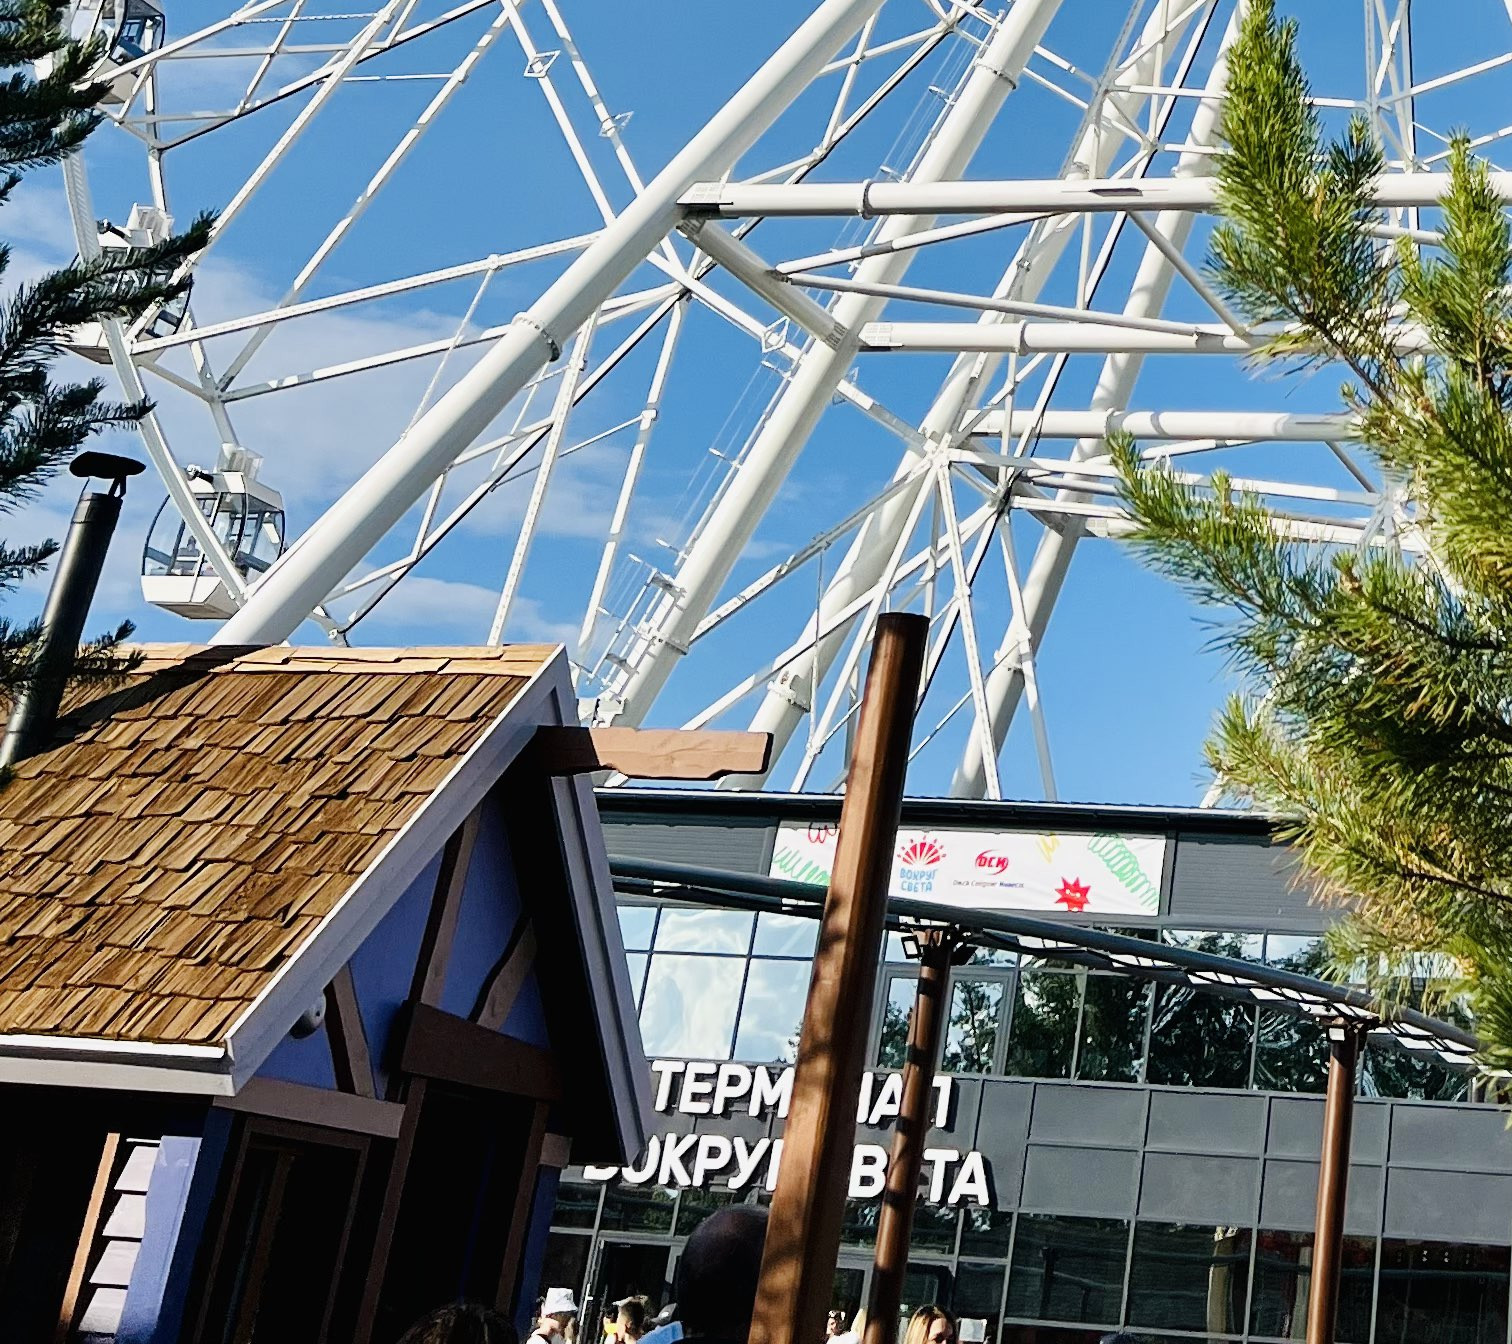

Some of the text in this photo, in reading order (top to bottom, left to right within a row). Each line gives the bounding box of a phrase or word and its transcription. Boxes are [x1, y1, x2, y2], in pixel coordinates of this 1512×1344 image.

[900, 868, 938, 881] ВОКРУГ
[901, 881, 932, 892] СВЕТА
[848, 1144, 990, 1206] ВТА
